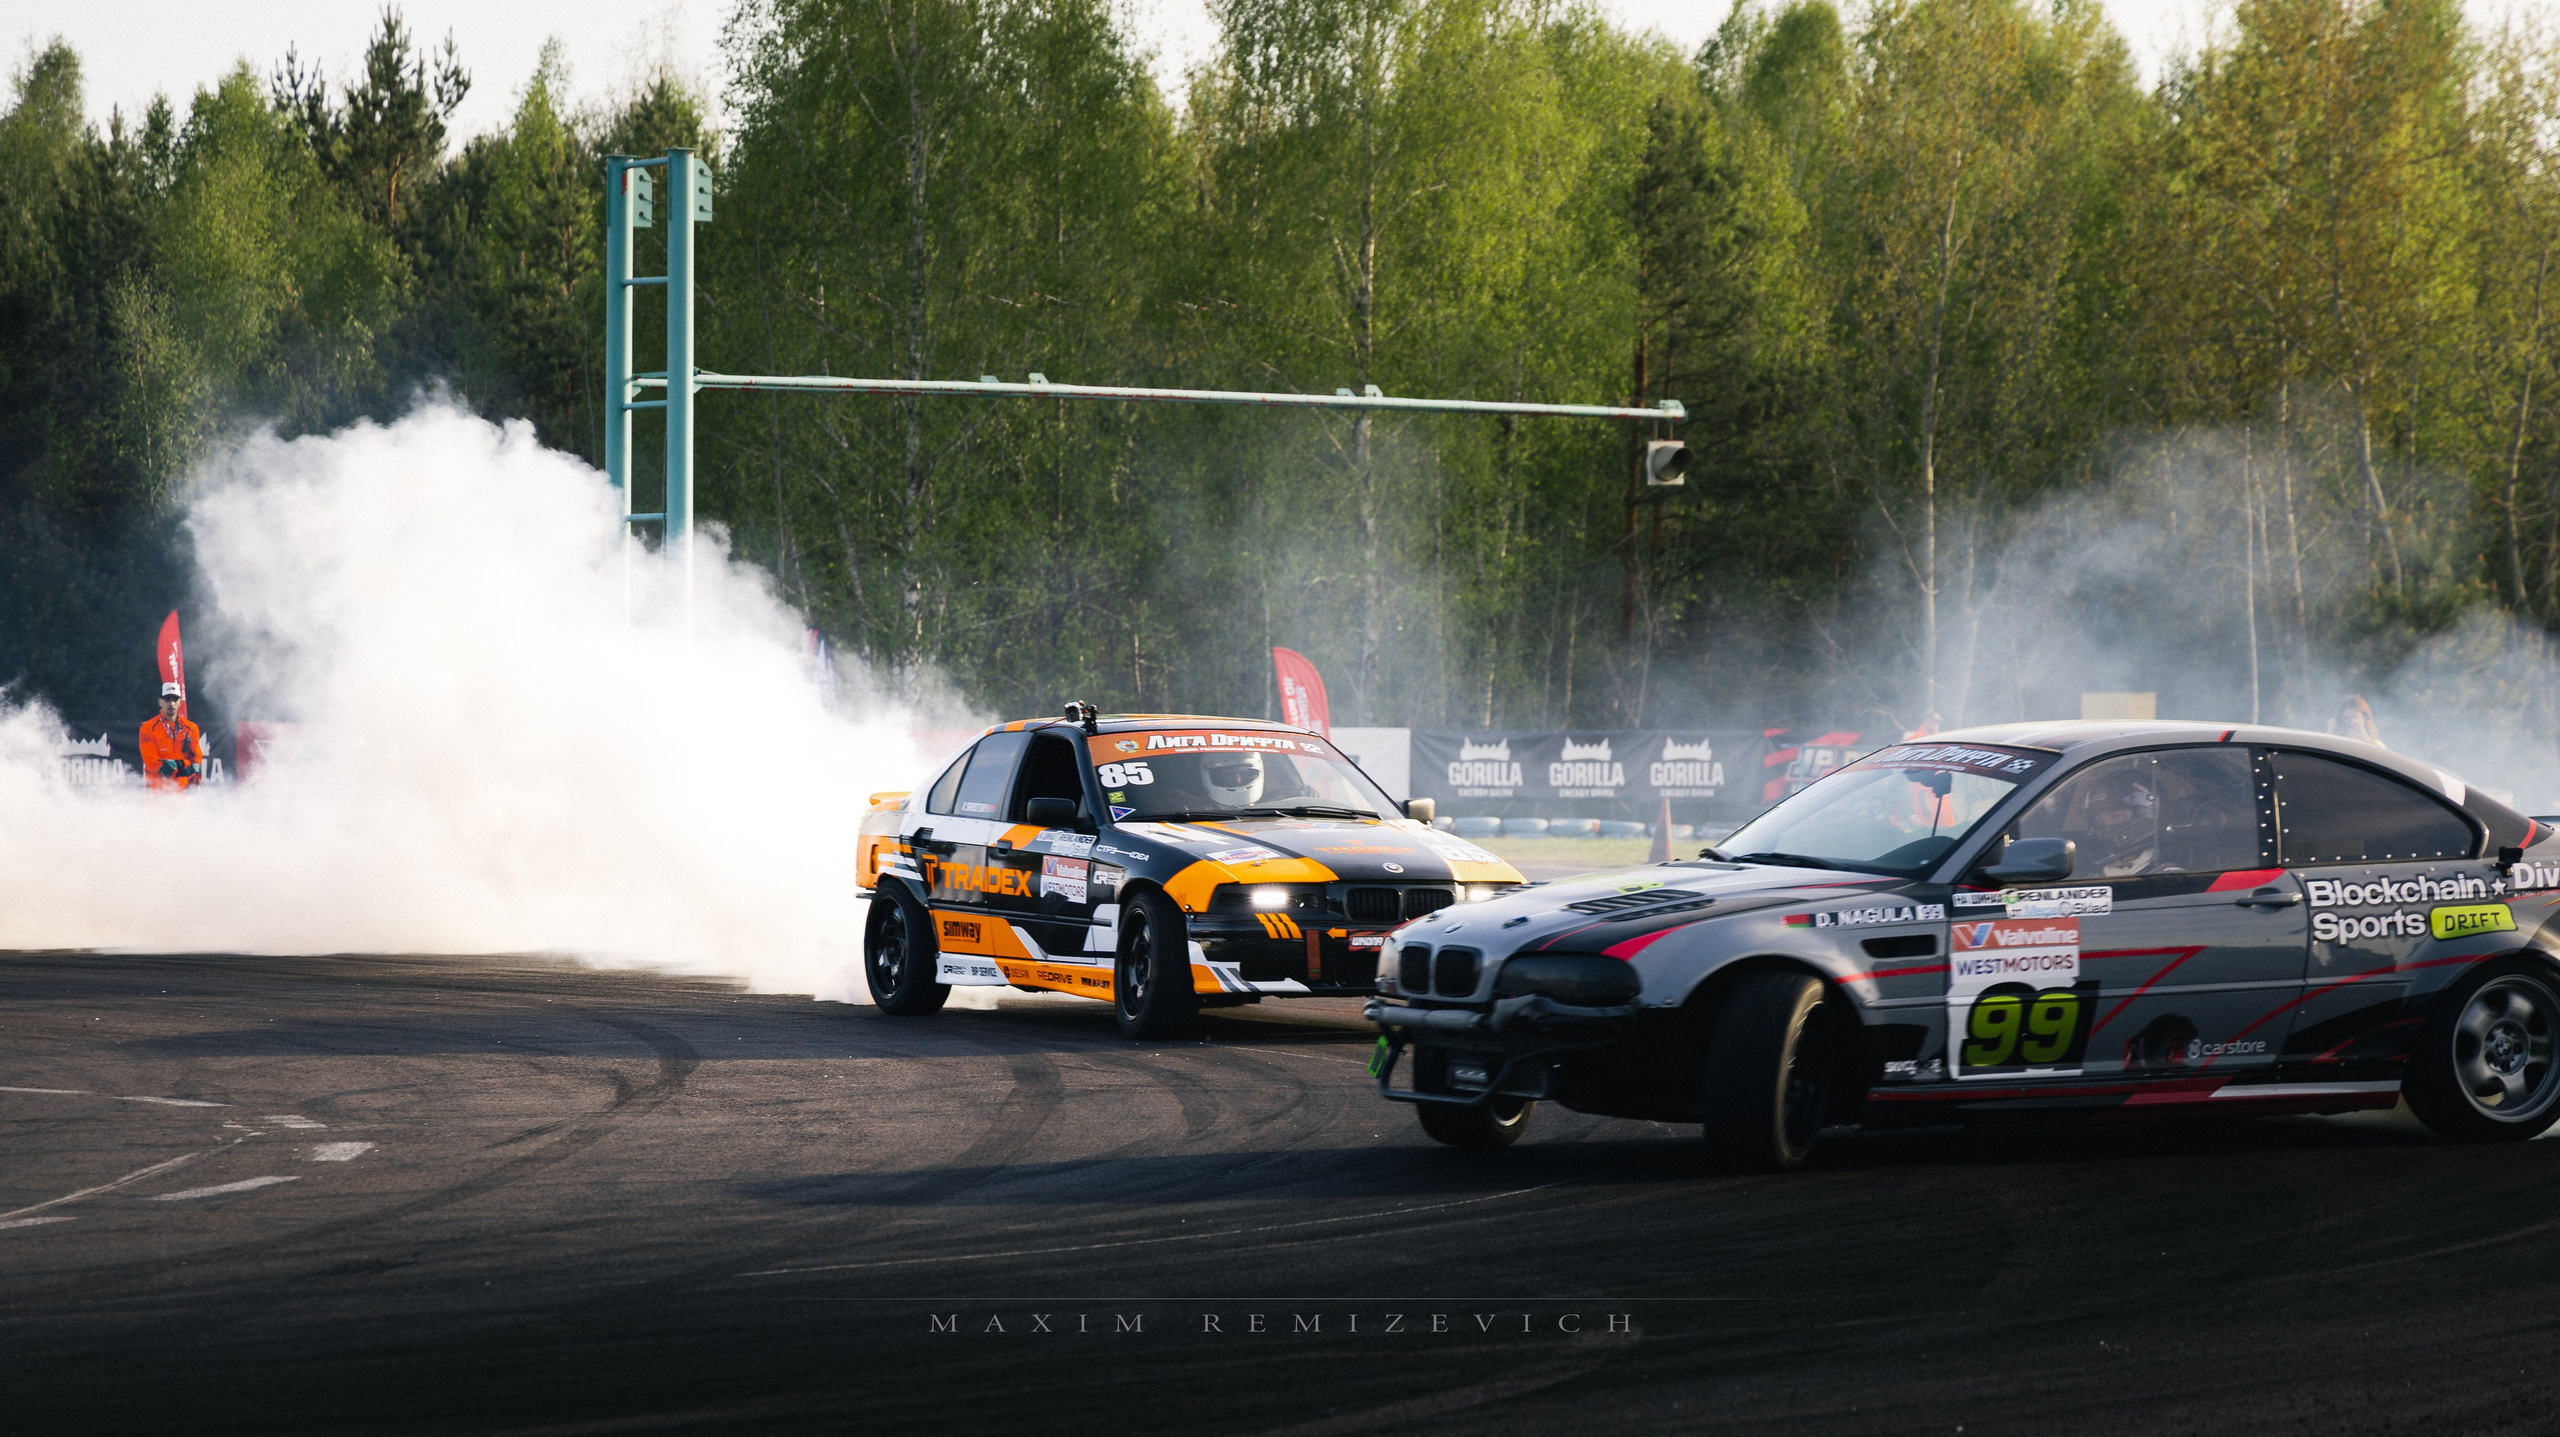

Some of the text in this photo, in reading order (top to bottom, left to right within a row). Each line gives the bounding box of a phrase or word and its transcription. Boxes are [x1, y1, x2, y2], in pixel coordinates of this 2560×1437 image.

[54, 758, 126, 785] ORILLA
[1099, 762, 1154, 788] 85
[1449, 762, 1523, 786] GORILLA
[1550, 762, 1625, 786] GORILLA
[1651, 762, 1725, 786] GORILLA
[1458, 789, 1514, 797] ENERGY DRINK
[1559, 789, 1615, 798] ENERGY DRINK
[1660, 789, 1715, 798] ENERGY DRINK
[939, 862, 1033, 897] TRADEX
[2306, 874, 2487, 907] Blockchain
[1838, 907, 1912, 926] NAGULA
[2313, 909, 2500, 945] Sports DRIFT
[944, 921, 981, 943] simway
[1993, 927, 2079, 946] Valvoline
[1956, 954, 2074, 976] WESTMOTORS
[1036, 970, 1073, 985] REDRIVE
[1966, 993, 2080, 1067] 99
[2202, 1039, 2267, 1055] carstore
